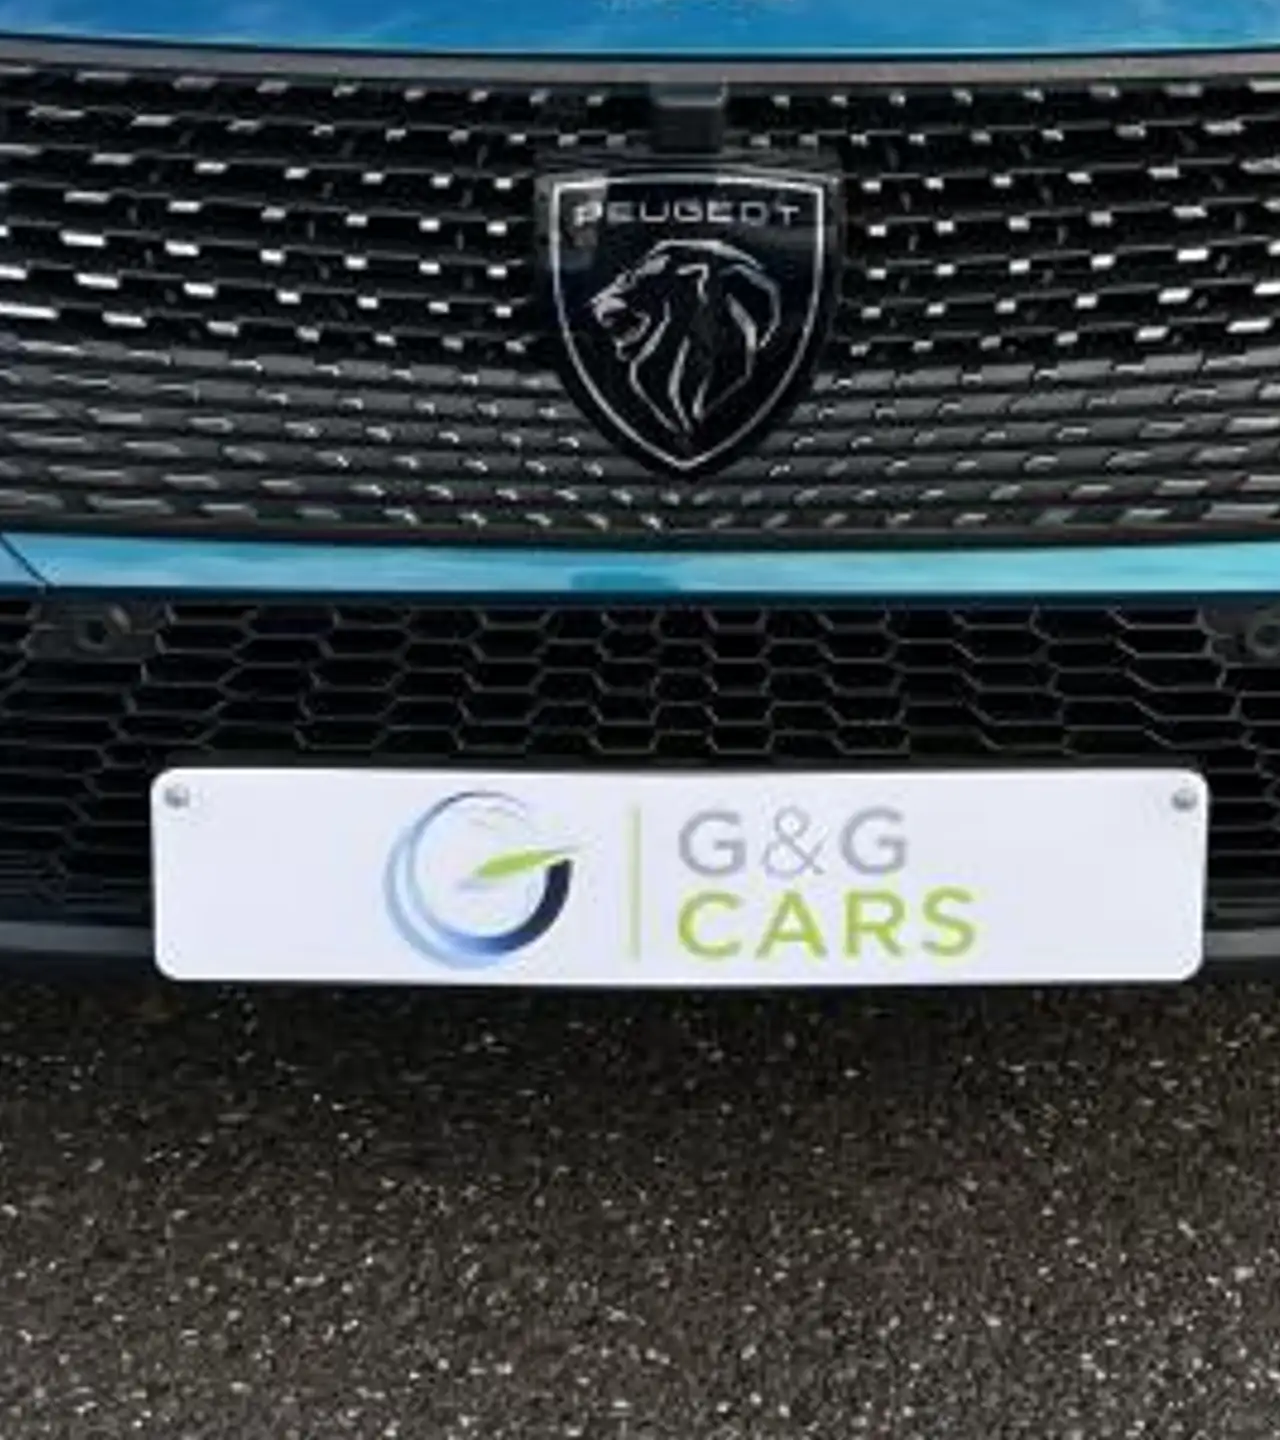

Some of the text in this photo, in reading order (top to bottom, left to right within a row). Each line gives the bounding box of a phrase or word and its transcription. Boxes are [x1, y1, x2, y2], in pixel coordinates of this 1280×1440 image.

[572, 198, 800, 227] PEUGEOT
[677, 807, 908, 879] G&G
[677, 886, 977, 960] CARS
